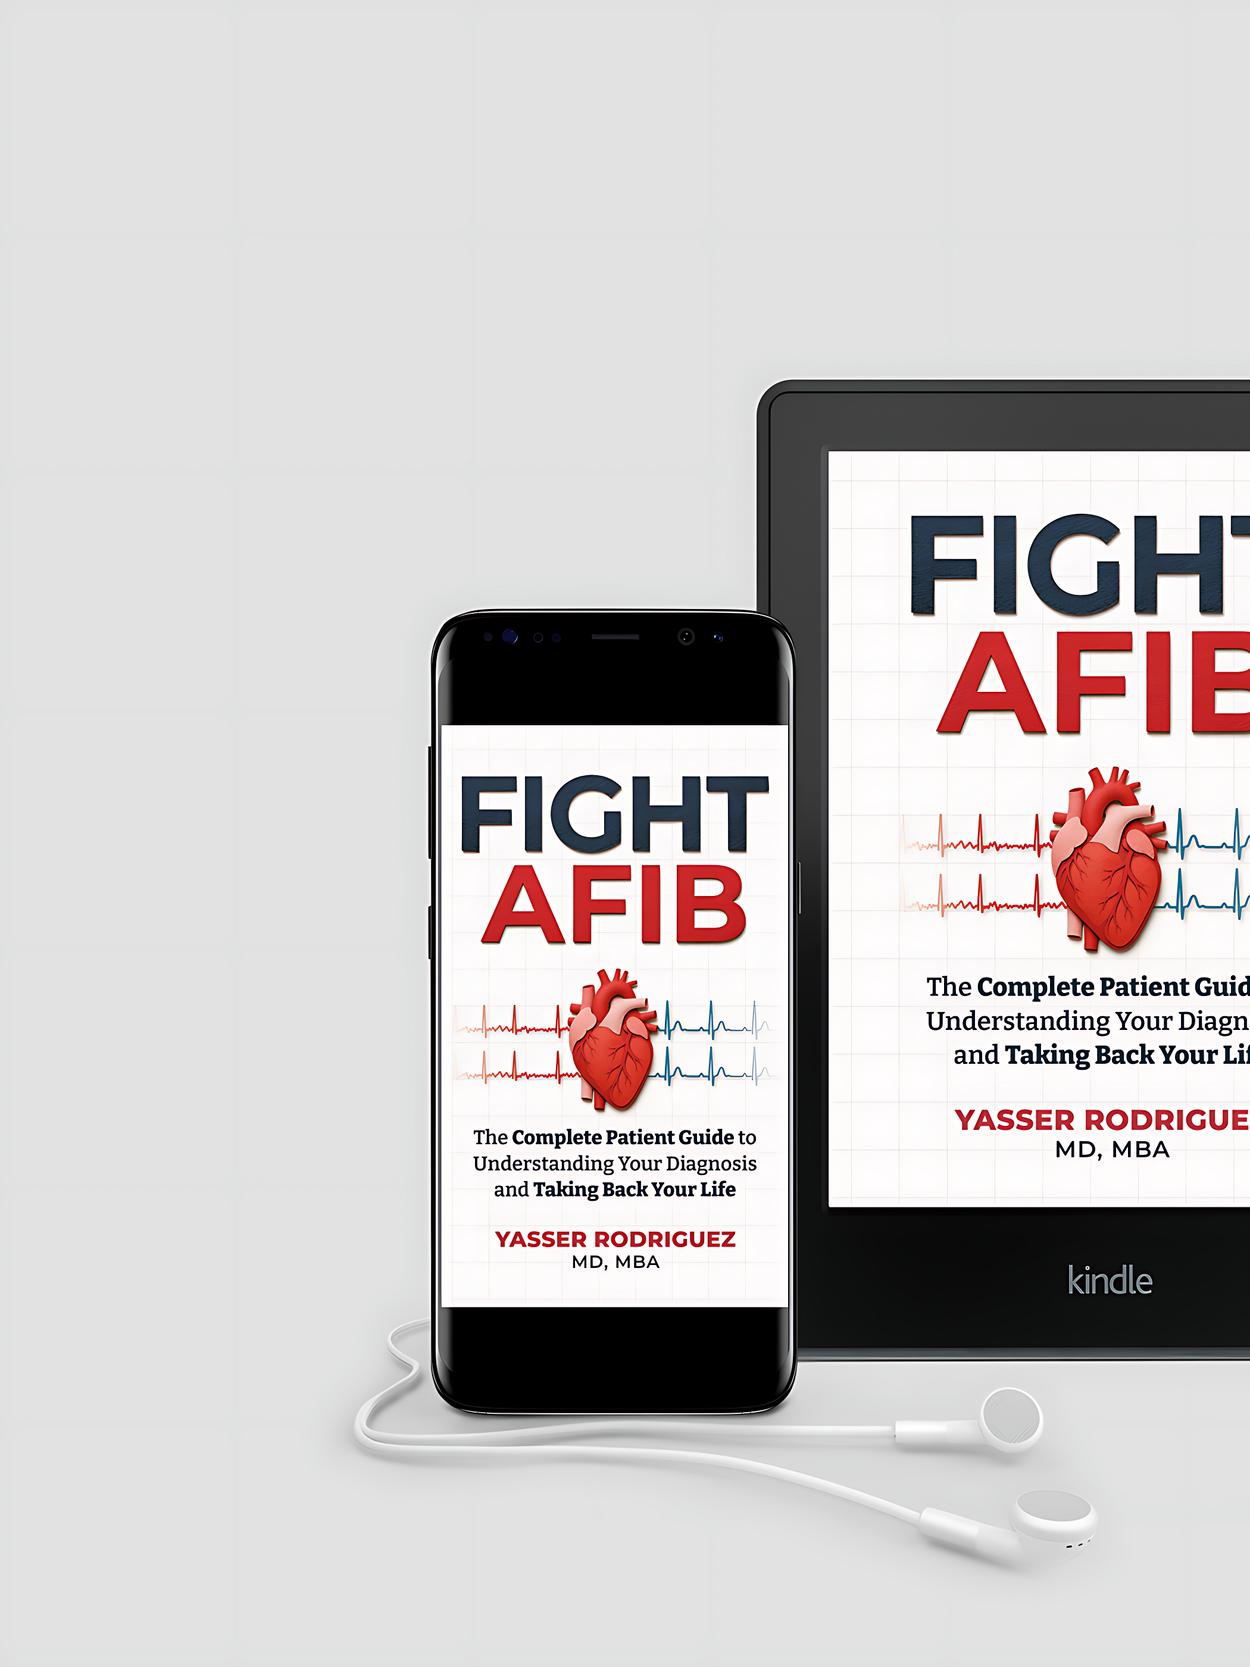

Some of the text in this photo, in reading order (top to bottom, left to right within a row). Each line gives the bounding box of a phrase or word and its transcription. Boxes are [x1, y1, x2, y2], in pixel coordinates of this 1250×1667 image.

[461, 774, 770, 855] FIGHT
[480, 864, 747, 945] AFIB
[926, 975, 972, 997] The
[977, 975, 1095, 1003] Complete
[1099, 974, 1191, 997] Patient
[926, 1009, 1111, 1037] Understanding
[1114, 1011, 1174, 1031] Your
[954, 1043, 1000, 1065] and
[1004, 1042, 1091, 1071] Taking
[1094, 1043, 1156, 1065] Back
[1158, 1044, 1219, 1065] Your
[954, 1108, 1075, 1131] YASSER
[473, 1128, 757, 1150] The Complete Patient Guide to
[1056, 1140, 1170, 1162] MD, MBA
[472, 1154, 758, 1176] Understanding Your Diagnosis
[494, 1180, 737, 1202] and Taking Back Your Life
[494, 1230, 736, 1248] YASSER RODRIGUEZ
[572, 1254, 660, 1272] MD, MBA
[1068, 1263, 1154, 1295] kindle
